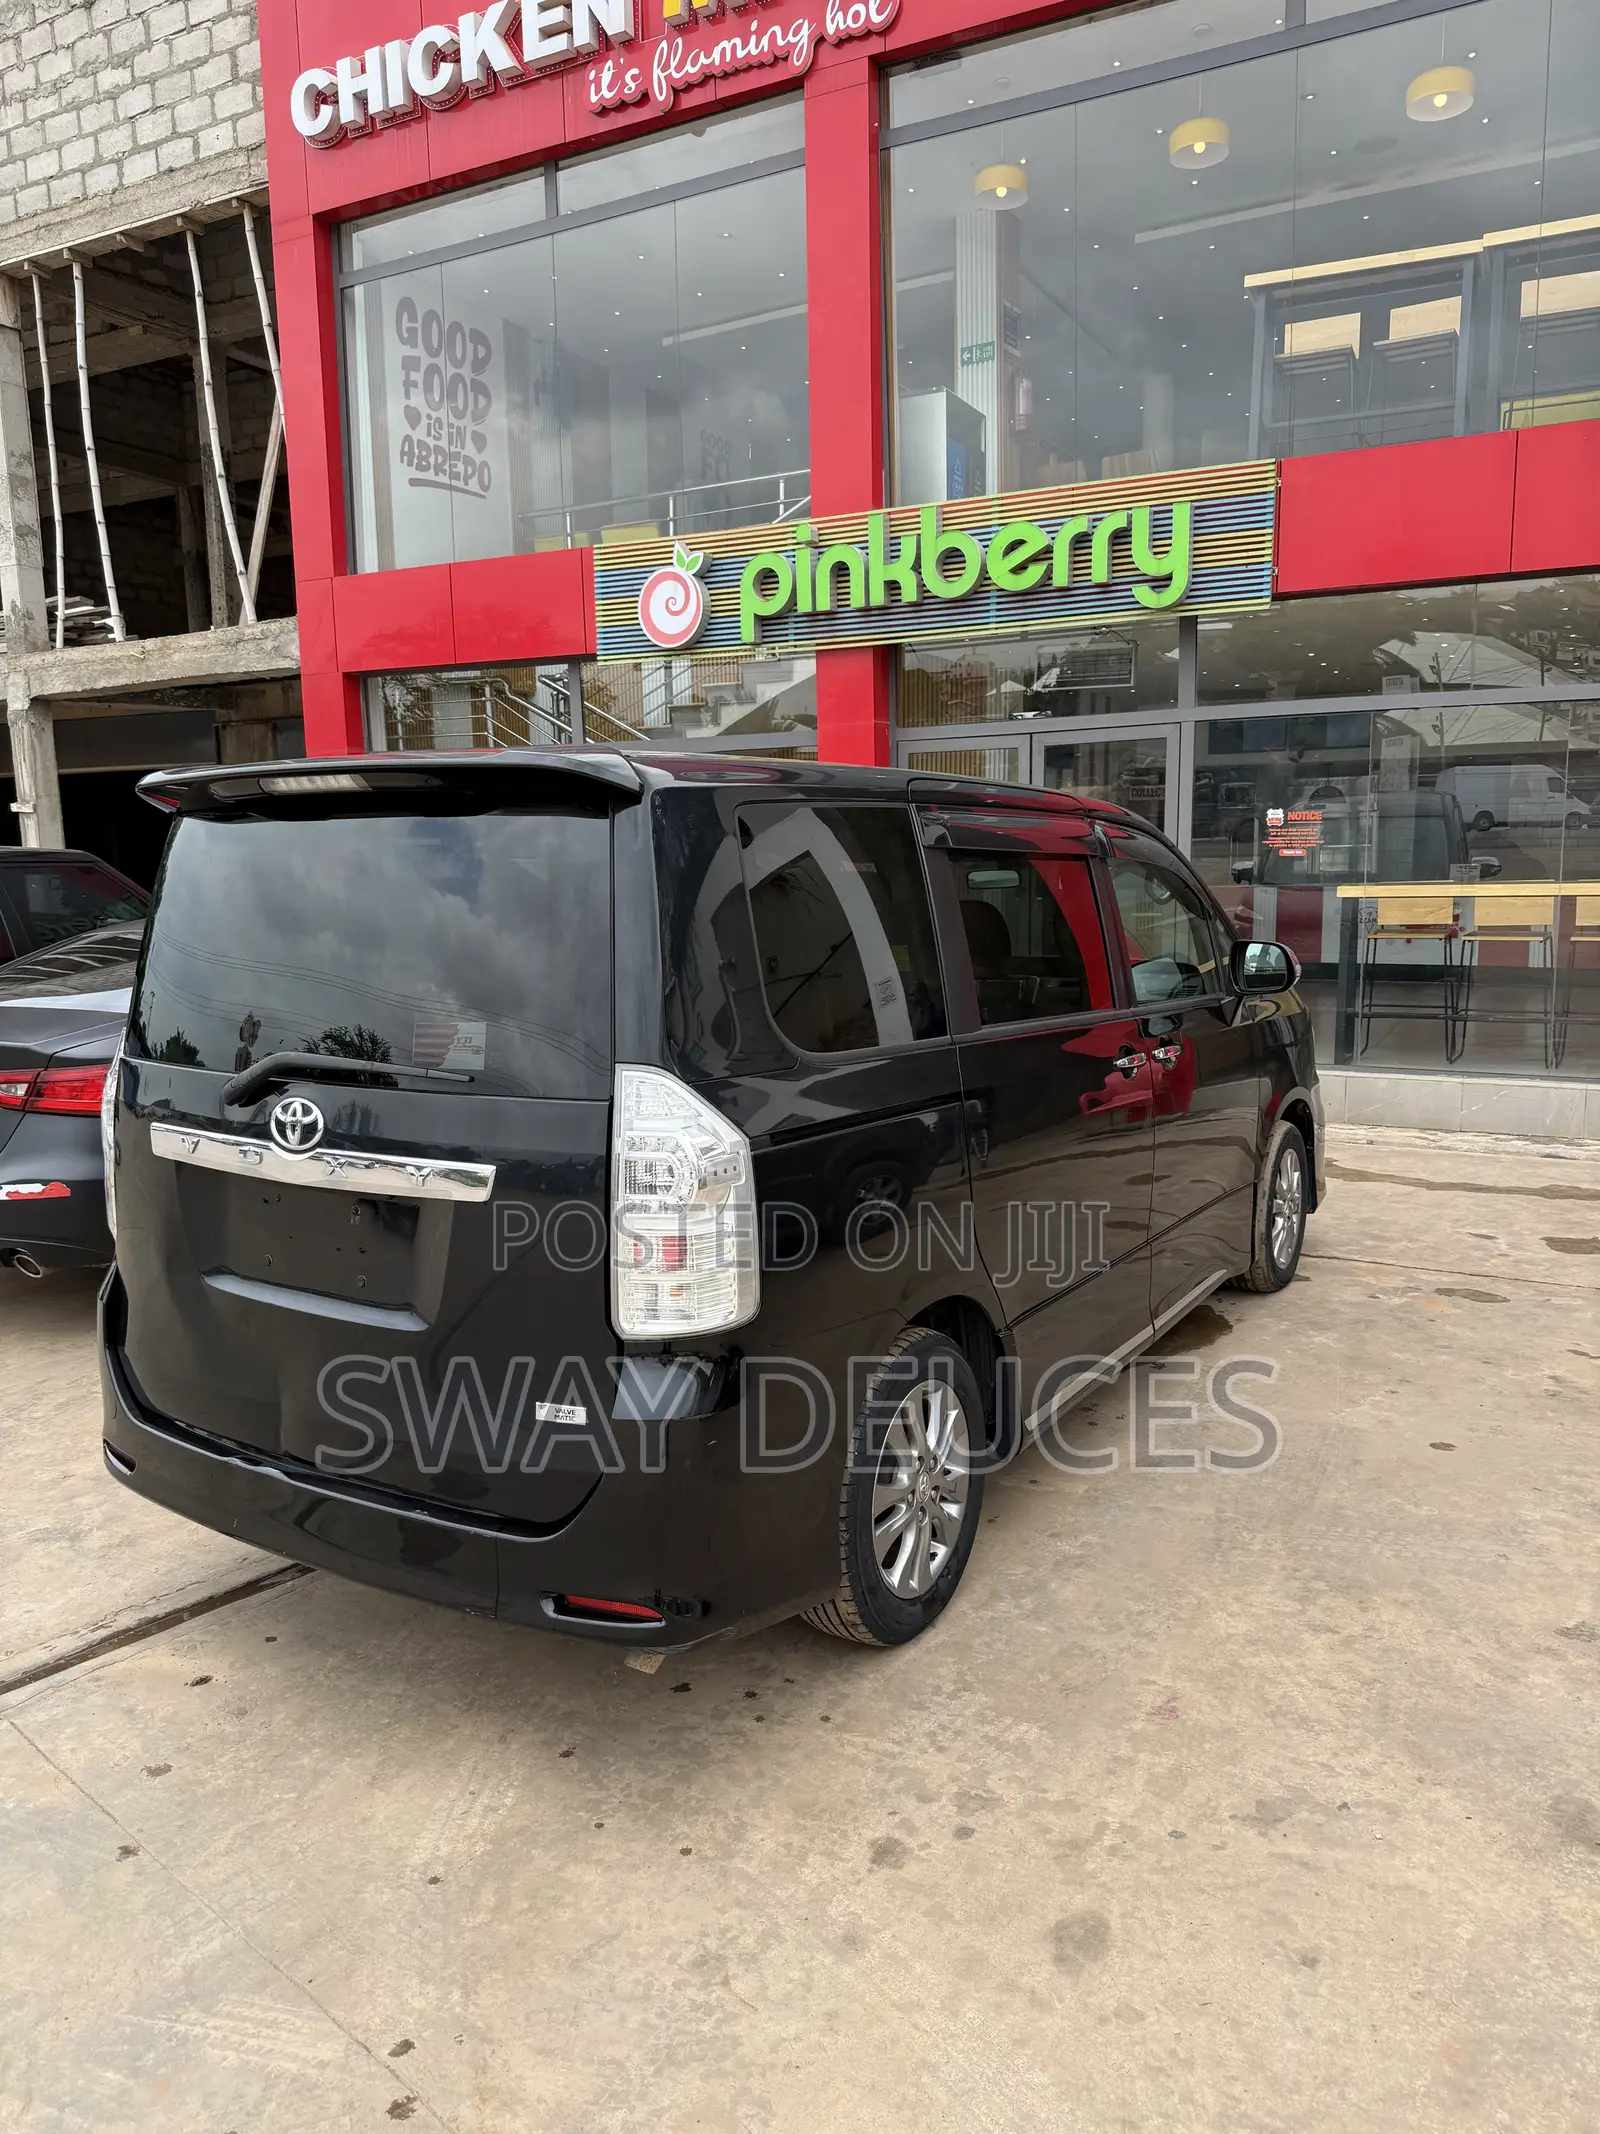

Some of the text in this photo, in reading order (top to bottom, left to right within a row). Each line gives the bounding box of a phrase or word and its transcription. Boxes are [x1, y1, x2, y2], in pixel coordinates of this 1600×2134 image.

[289, 0, 633, 137] CHICKEN
[588, 57, 642, 104] it's
[652, 18, 817, 101] flaming
[395, 296, 493, 375] GOOD
[401, 354, 493, 425] FOOD
[400, 433, 492, 493] ABREPO
[740, 502, 1194, 643] pinkberry
[1287, 811, 1323, 821] NOTICE
[180, 1134, 436, 1188] VOXY
[554, 1407, 577, 1416] VALVE
[554, 1414, 577, 1423] MATIC
